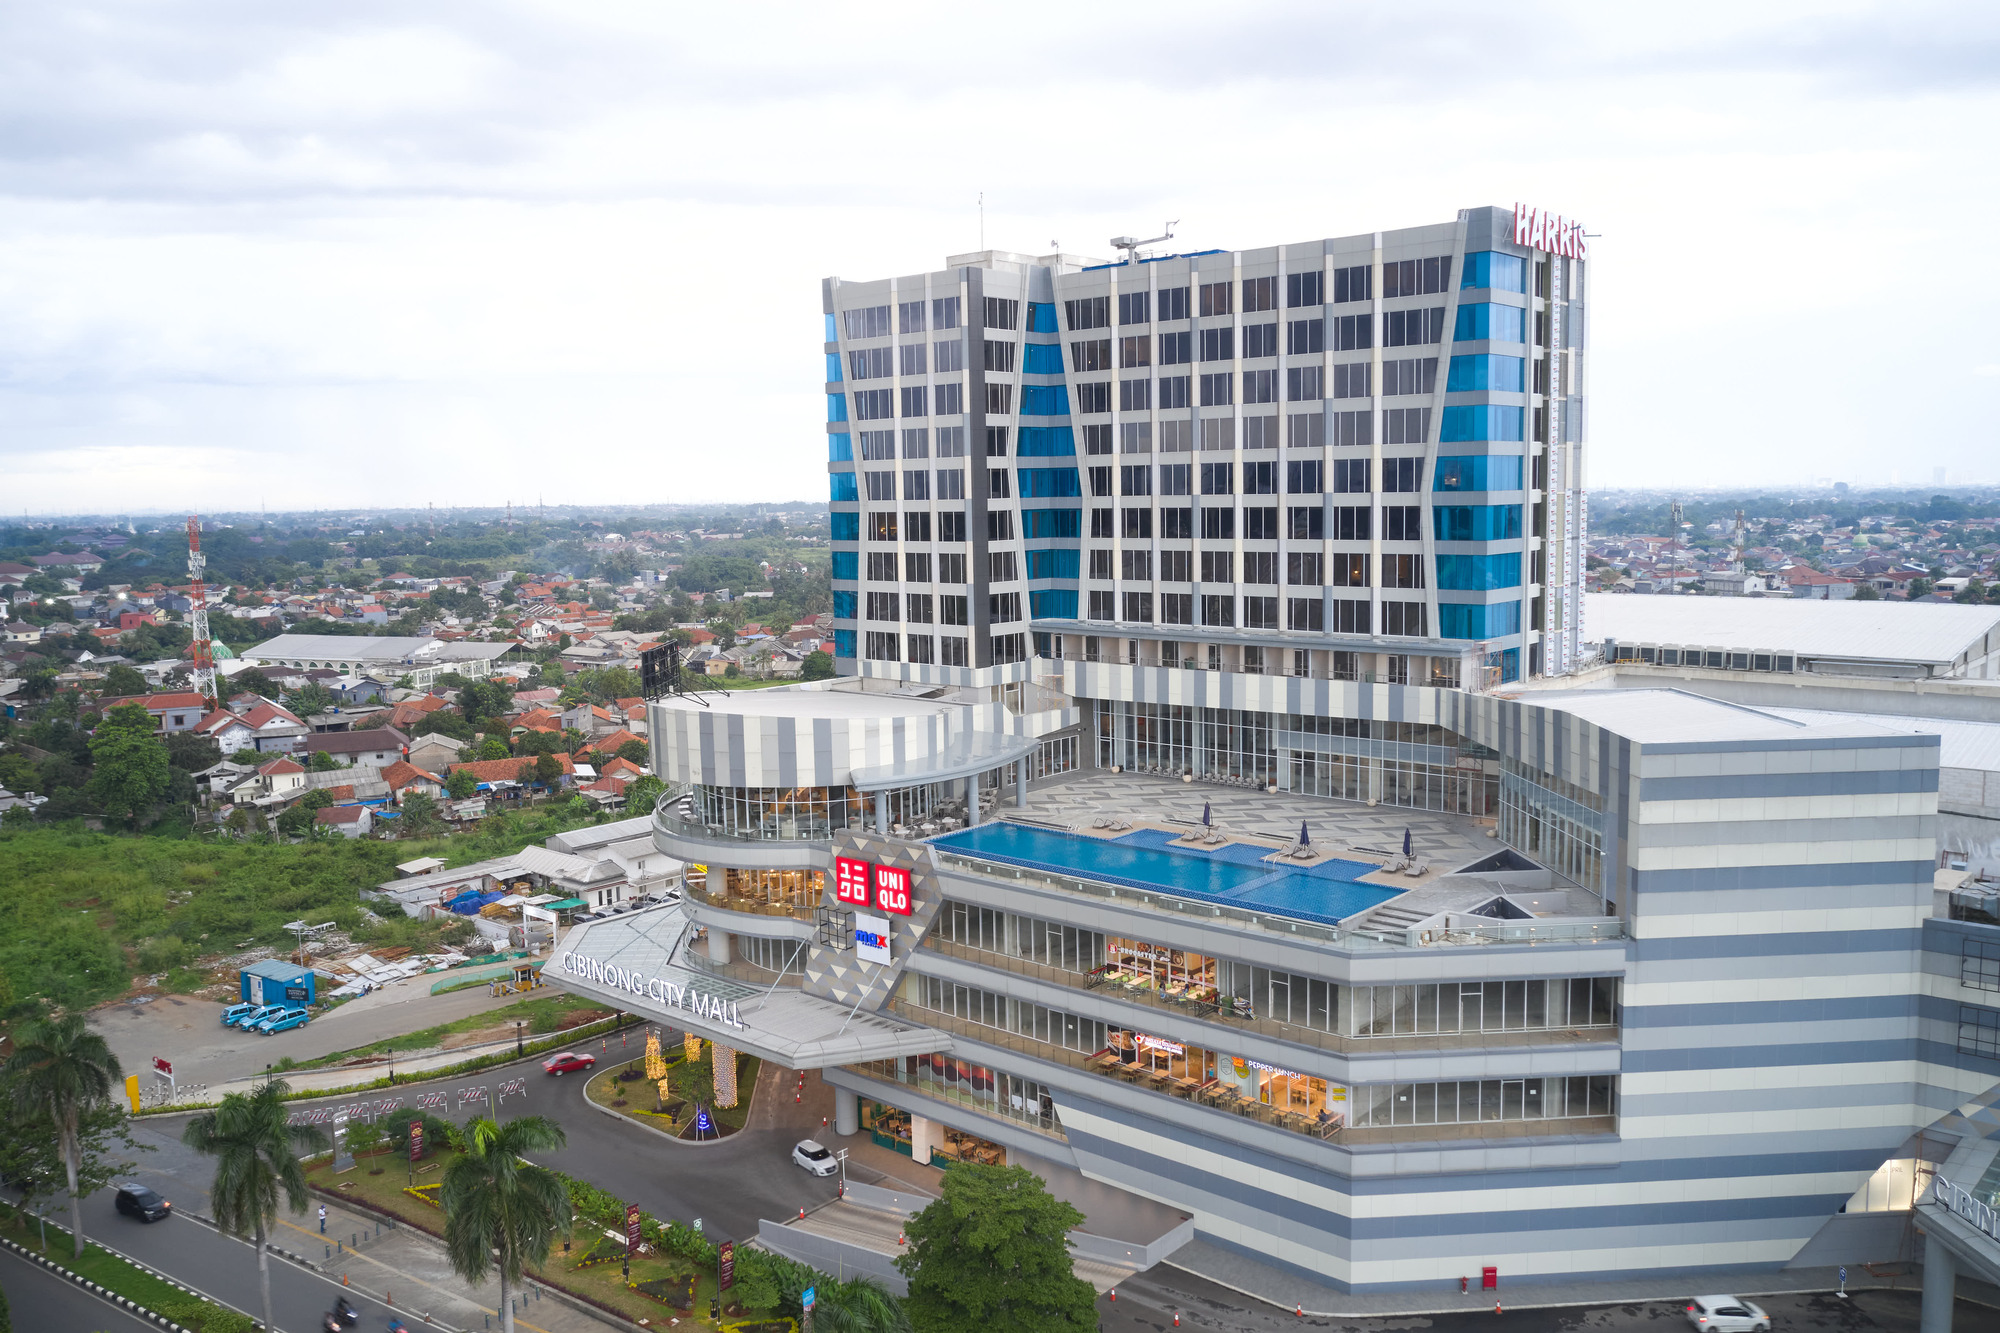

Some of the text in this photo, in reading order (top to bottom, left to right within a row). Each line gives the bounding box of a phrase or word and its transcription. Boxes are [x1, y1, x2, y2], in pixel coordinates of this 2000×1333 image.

[1514, 202, 1588, 261] HARRIS
[840, 862, 864, 882] ユニ
[878, 870, 904, 891] UNI
[840, 881, 865, 901] クロ
[879, 889, 907, 909] QLO
[856, 930, 888, 947] max
[563, 951, 743, 1029] CIBINONG CITY MALL
[1248, 1060, 1274, 1073] PEPPER
[1274, 1067, 1301, 1080] LUNCH
[1931, 1174, 2000, 1243] CIBIN
